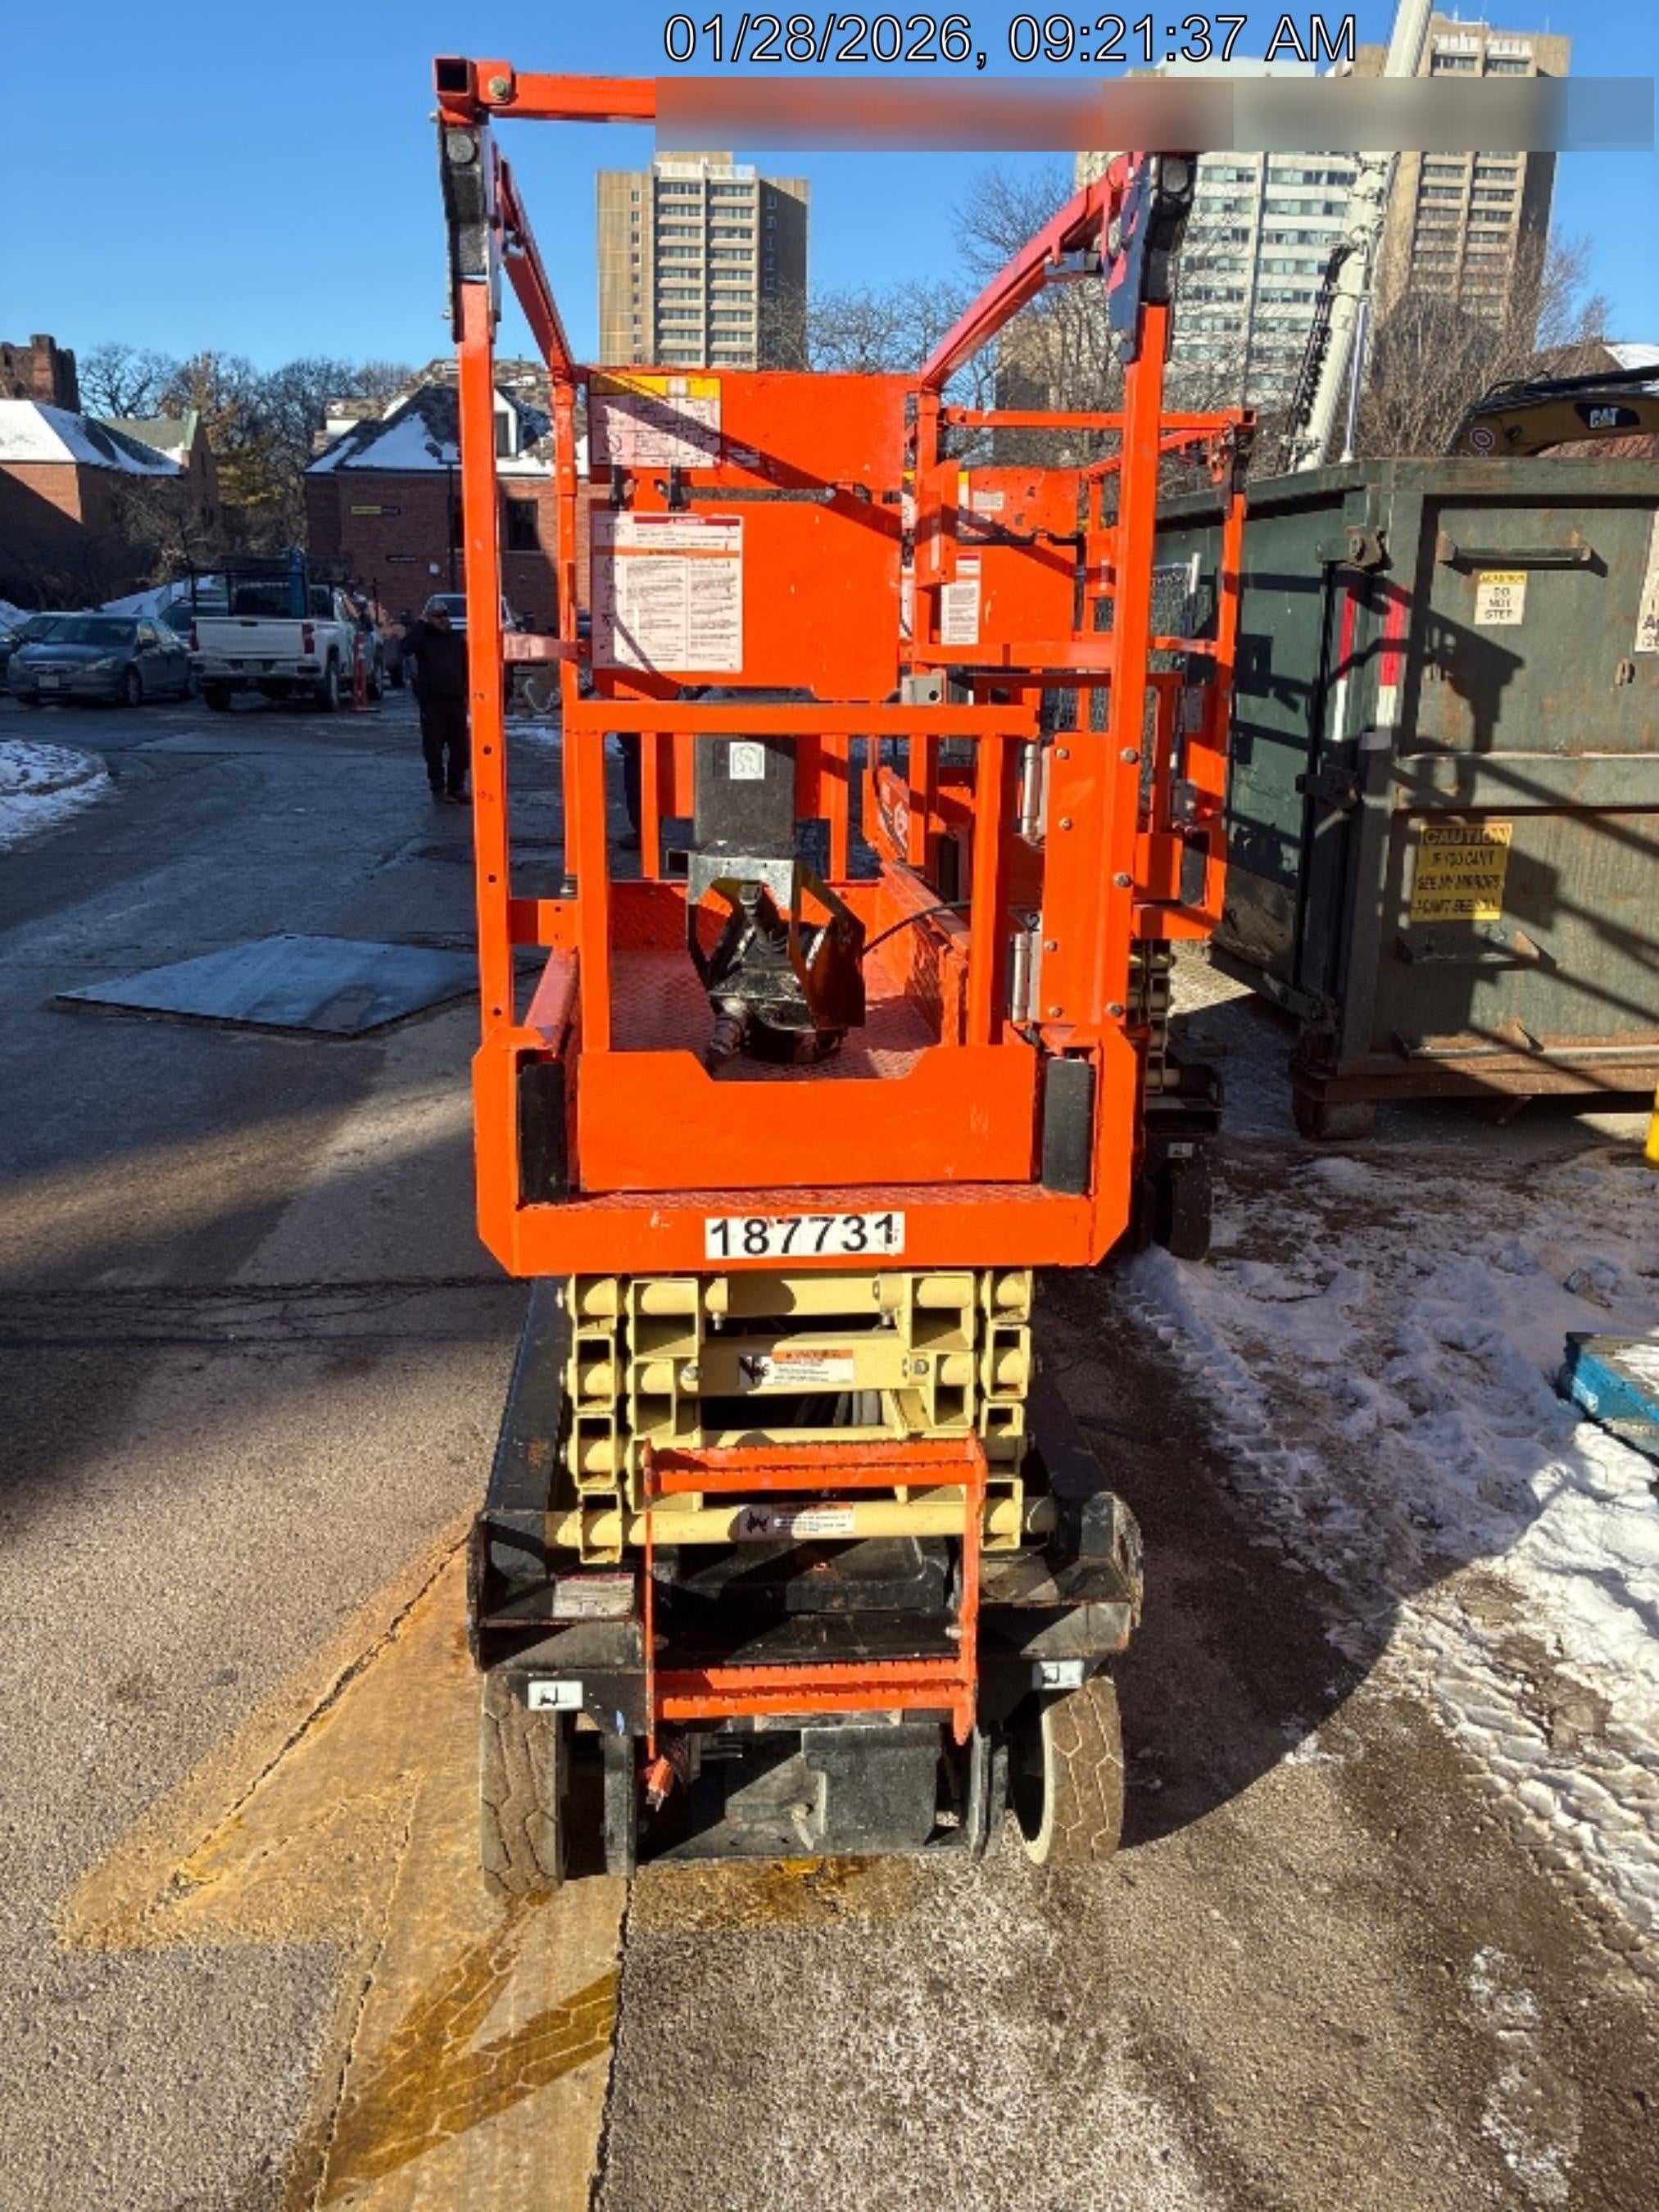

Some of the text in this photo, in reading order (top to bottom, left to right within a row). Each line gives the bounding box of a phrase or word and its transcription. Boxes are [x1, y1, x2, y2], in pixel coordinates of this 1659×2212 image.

[1589, 407, 1619, 428] CAT
[1424, 827, 1511, 845] CAUTION
[710, 1213, 894, 1257] 187731
